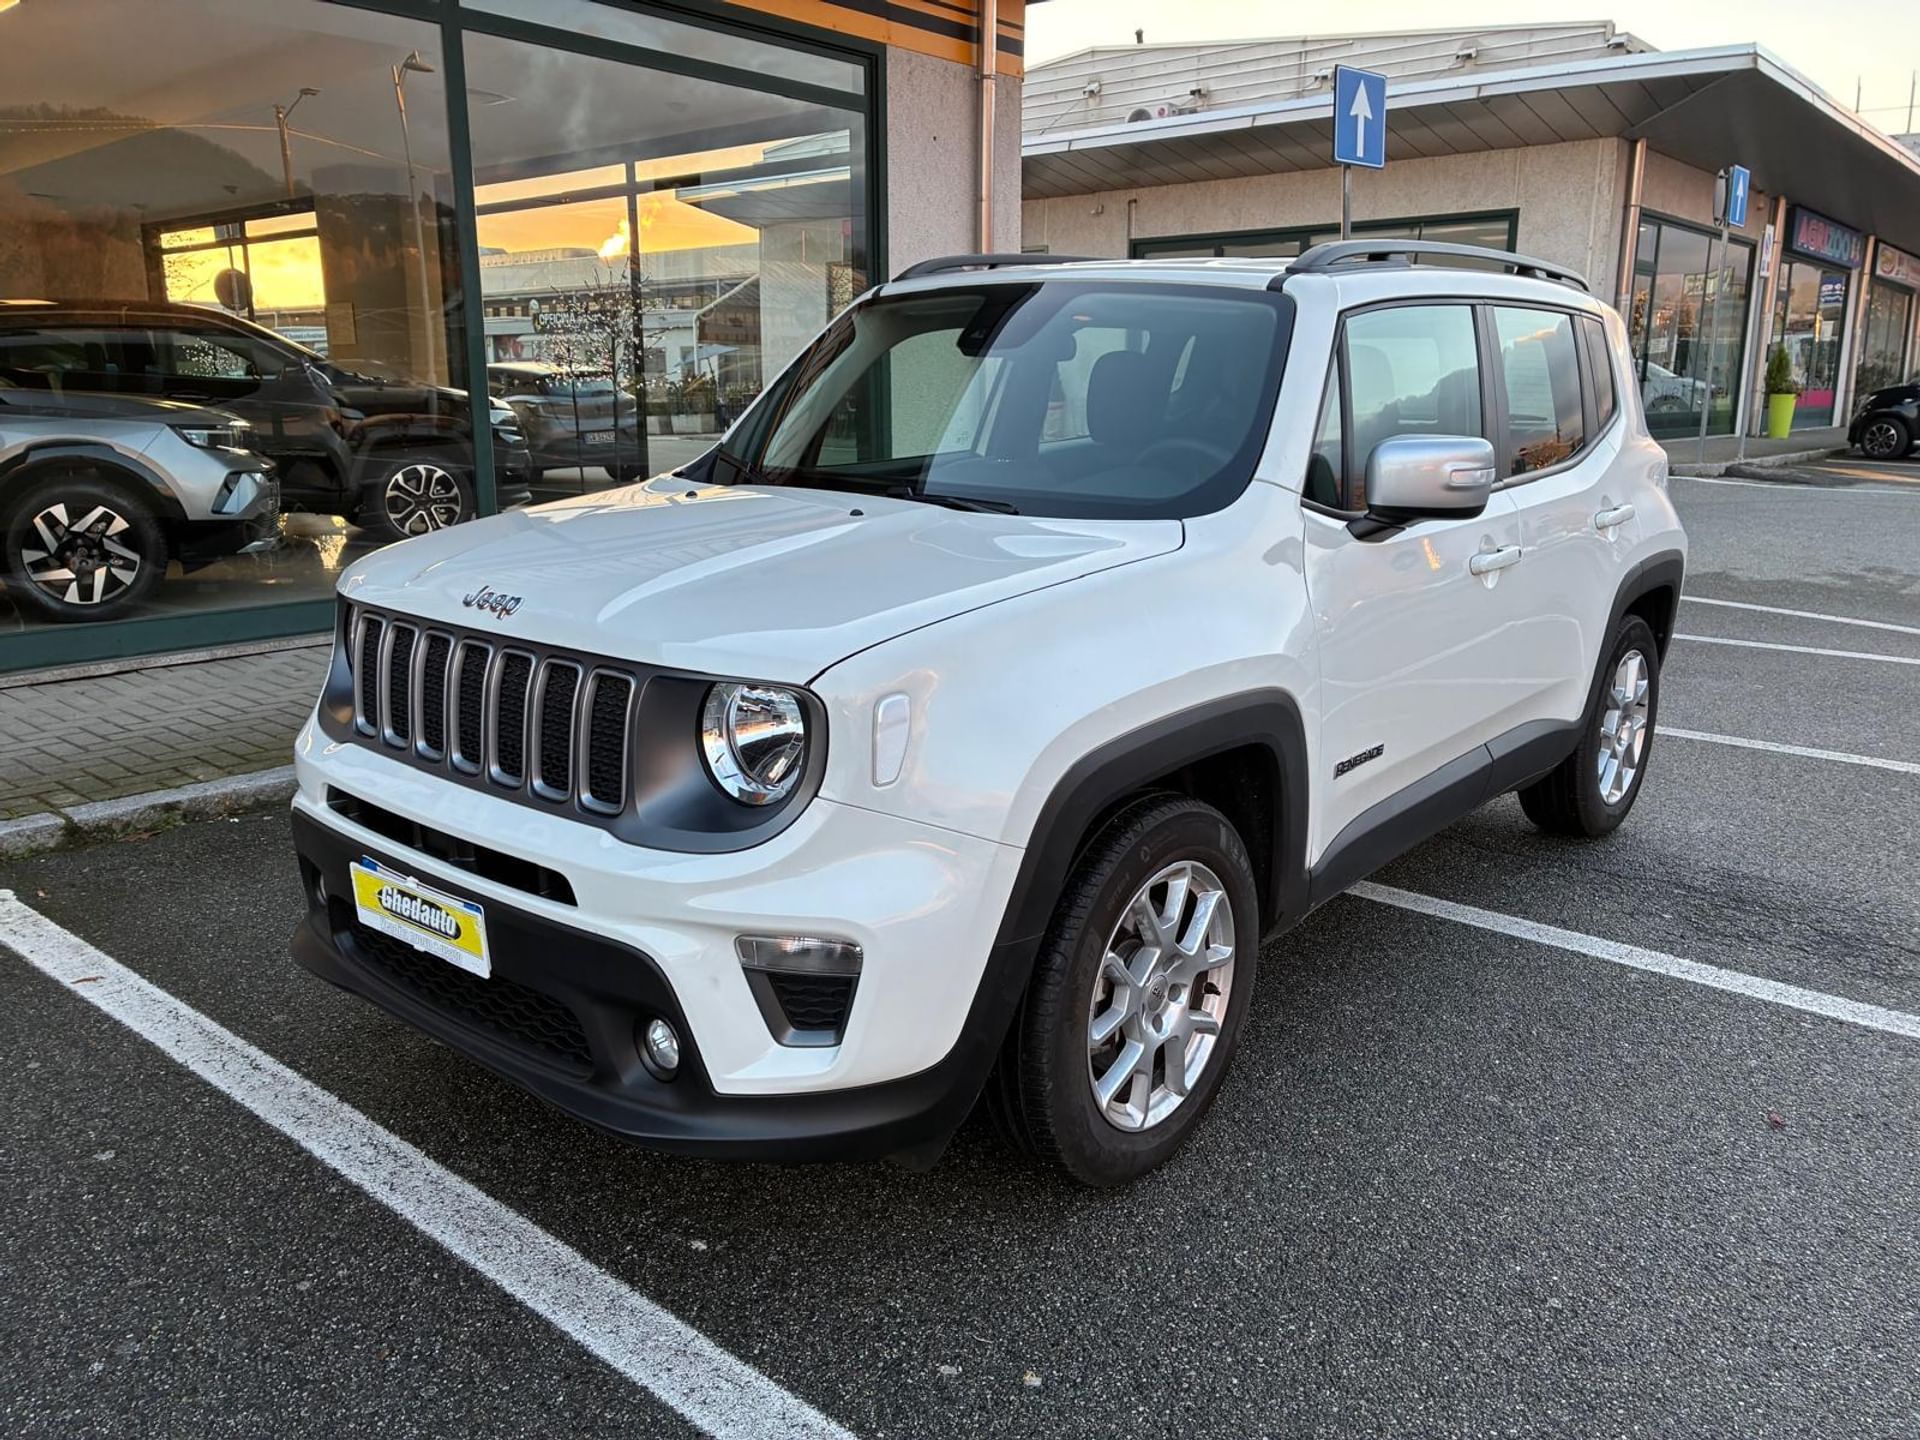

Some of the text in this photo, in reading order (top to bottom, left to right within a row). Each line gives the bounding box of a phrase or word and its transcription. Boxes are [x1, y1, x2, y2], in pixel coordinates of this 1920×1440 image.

[463, 585, 523, 620] Jeep
[1333, 743, 1385, 780] RENEGADE
[381, 885, 457, 936] Ghedauto
